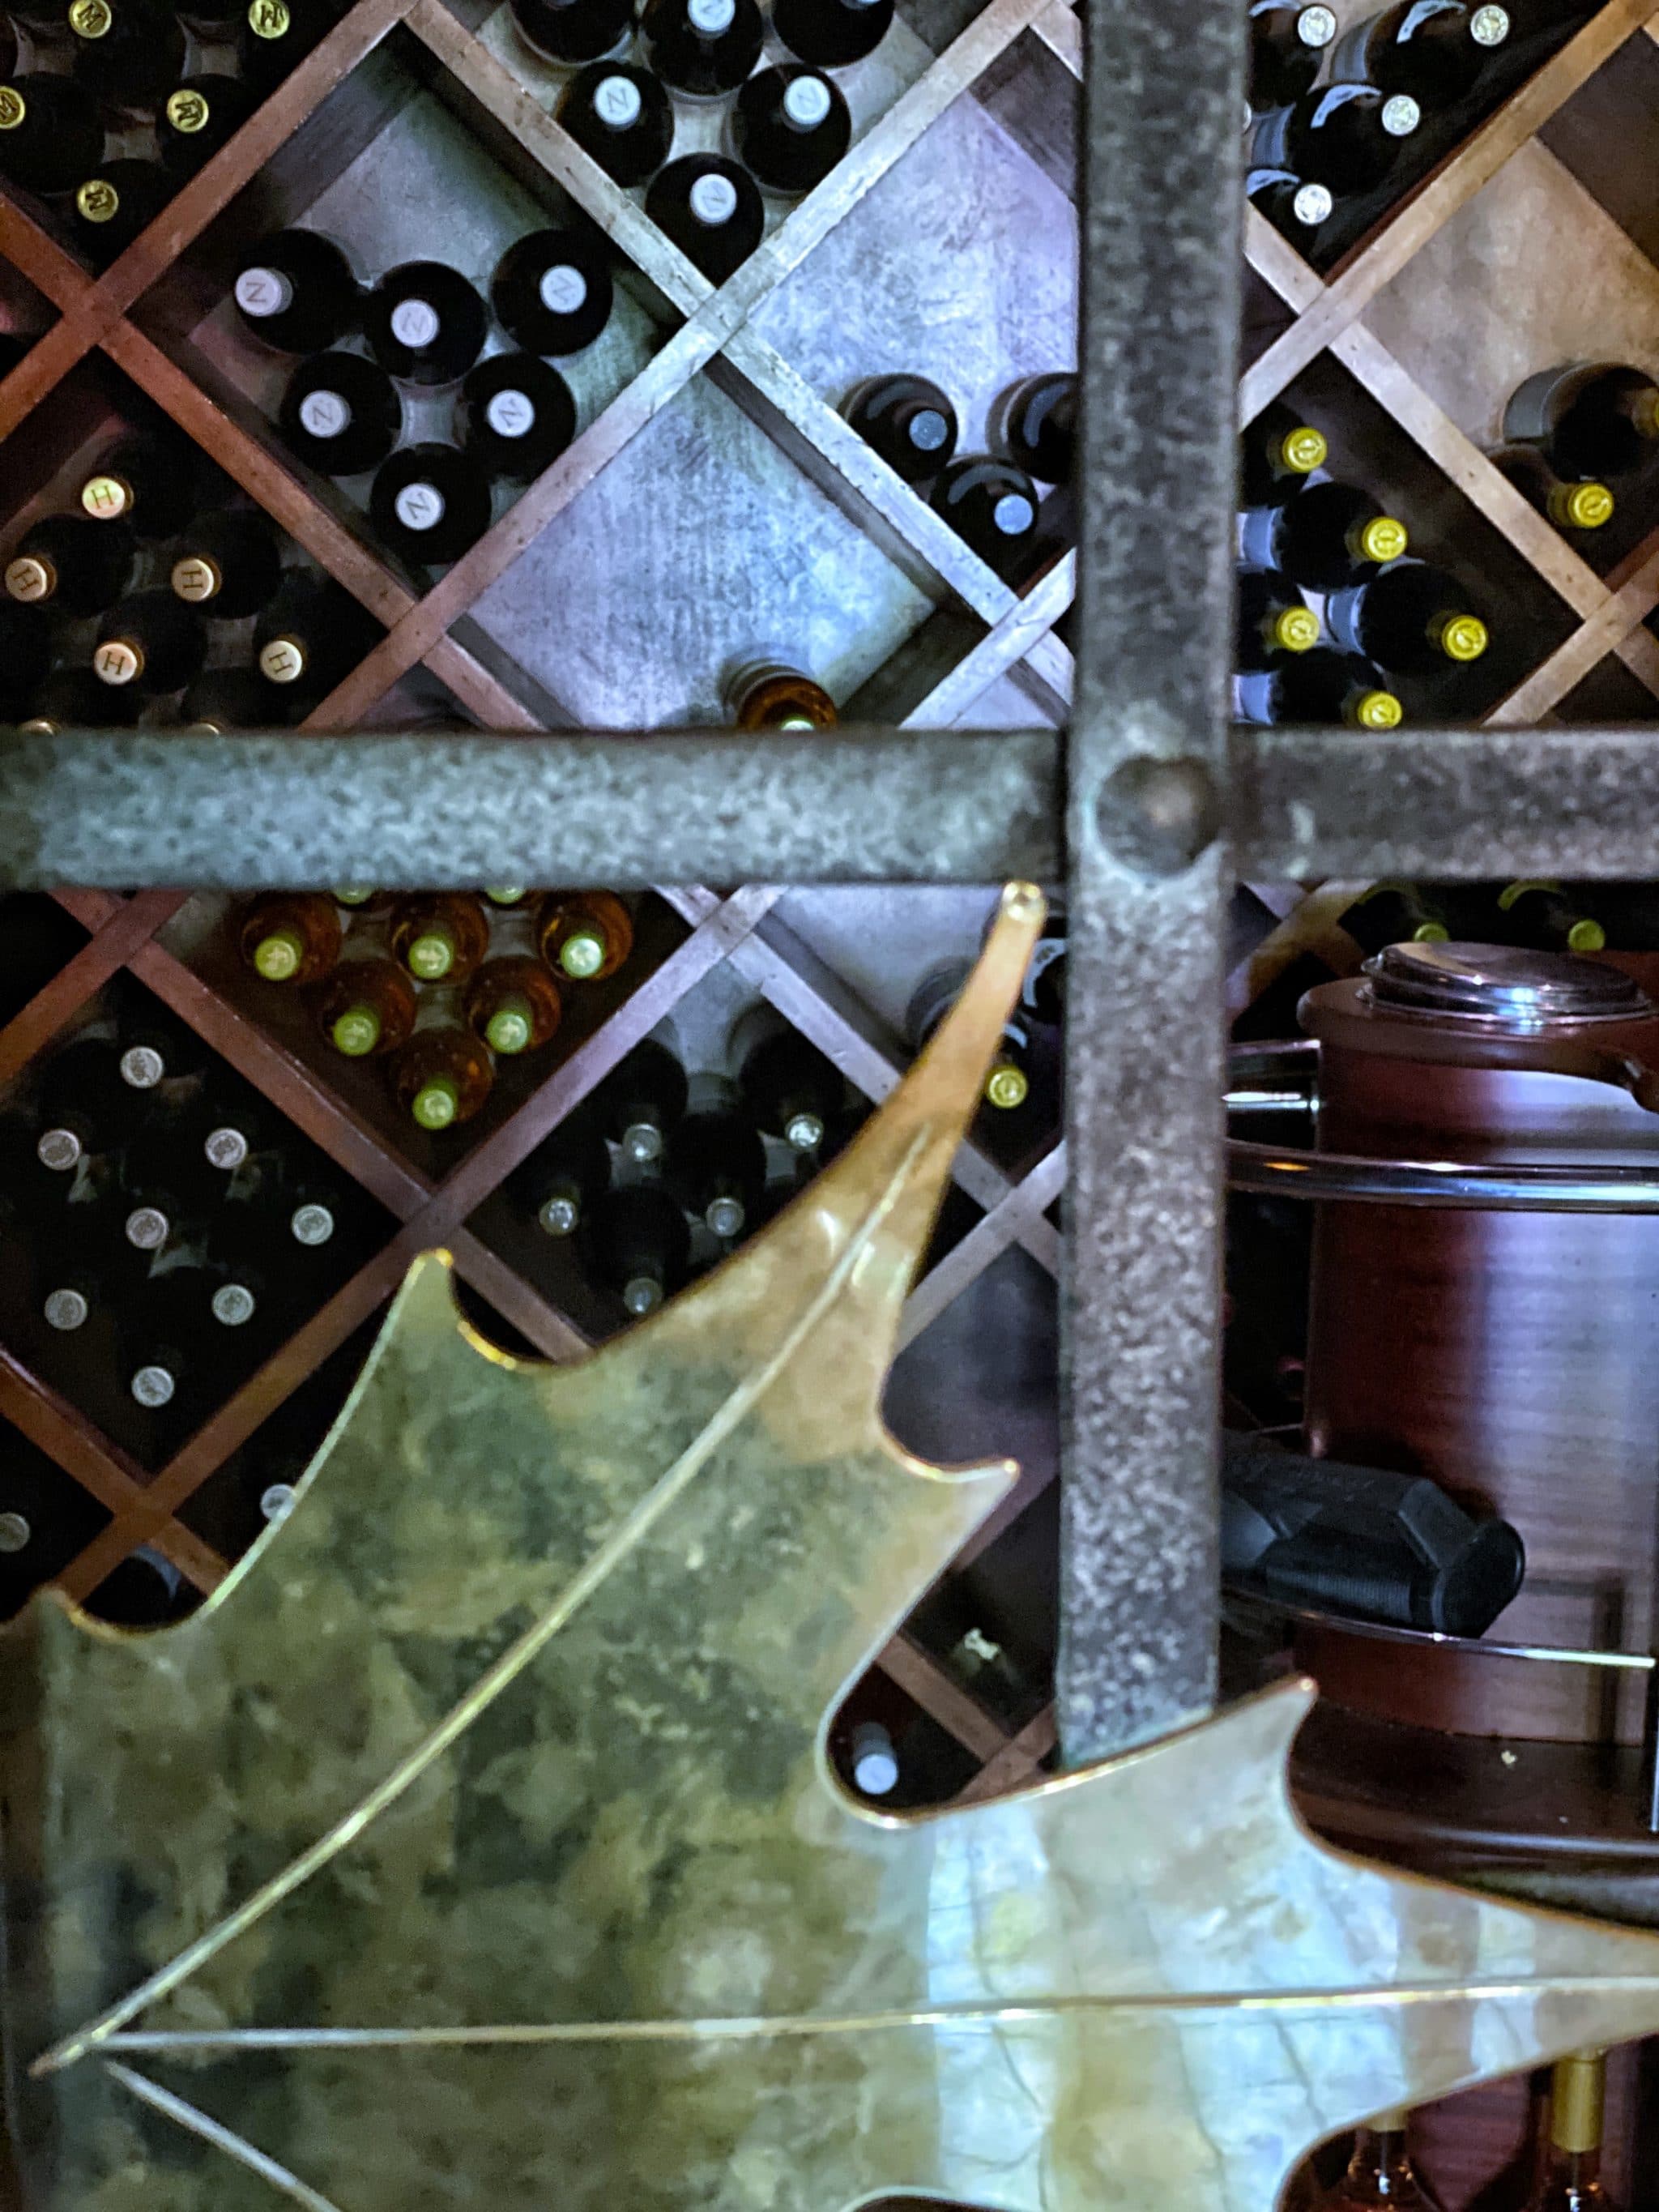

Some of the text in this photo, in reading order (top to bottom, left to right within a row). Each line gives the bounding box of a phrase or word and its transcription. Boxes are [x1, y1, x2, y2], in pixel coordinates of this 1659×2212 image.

[605, 87, 629, 113] N
[312, 402, 333, 425] N
[90, 485, 114, 509] H
[12, 566, 40, 593] H
[181, 568, 203, 589] H
[102, 651, 126, 676] H
[268, 651, 294, 674] H
